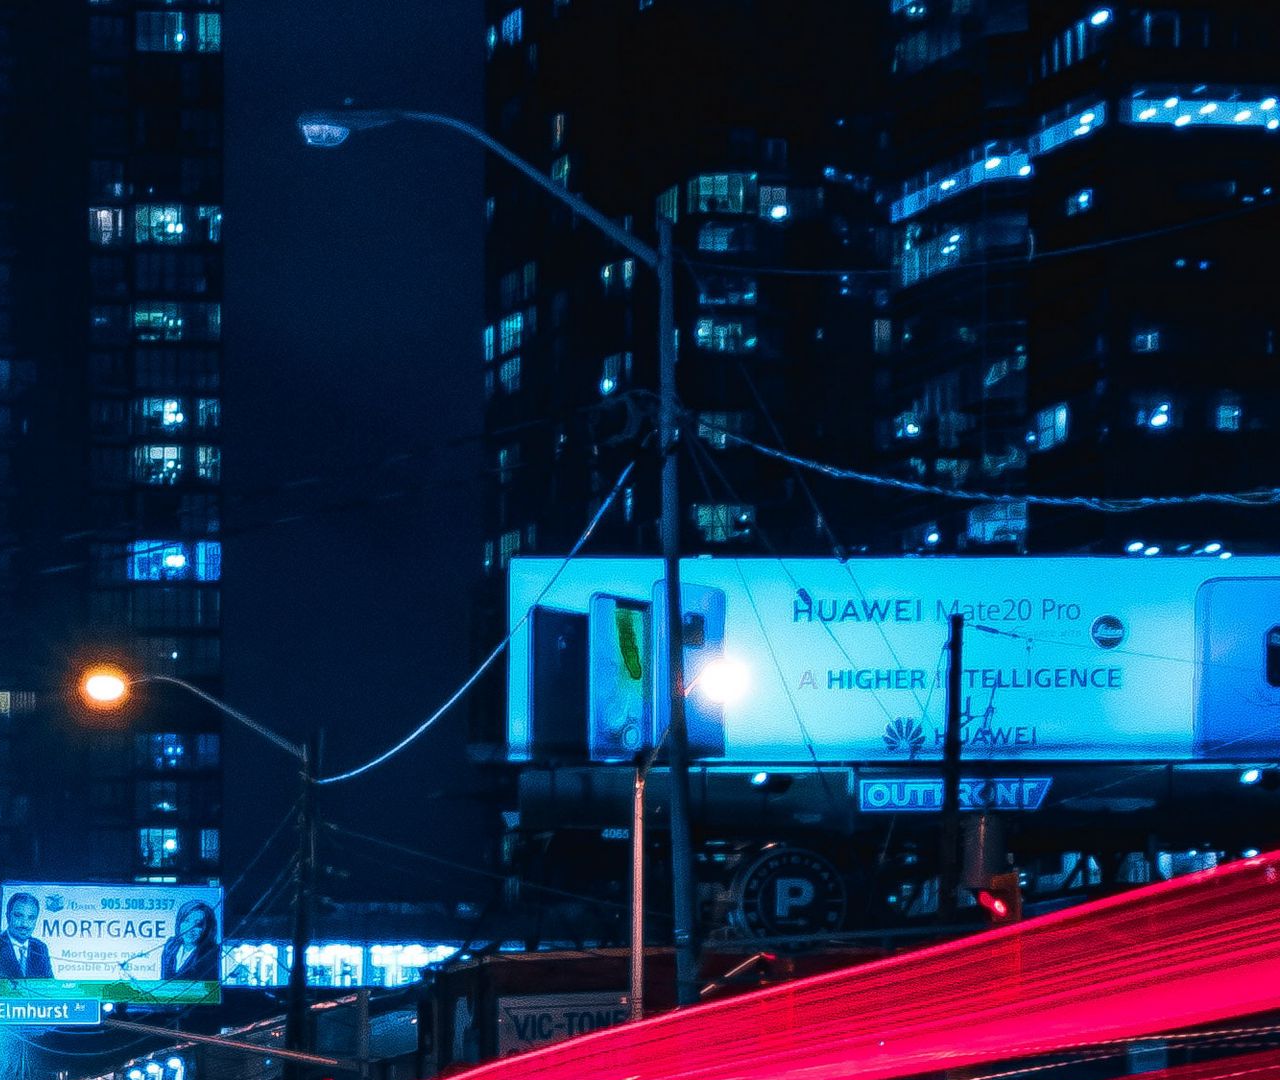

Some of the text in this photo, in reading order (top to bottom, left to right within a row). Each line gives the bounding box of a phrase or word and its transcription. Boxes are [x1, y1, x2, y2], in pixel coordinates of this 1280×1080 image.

[793, 598, 1082, 622] HUAWEI Mate20 Pro
[798, 669, 818, 690] A
[827, 669, 926, 690] HIGHER
[775, 877, 815, 918] P
[41, 919, 167, 938] MORTGAGE
[61, 949, 118, 961] Mortgages
[57, 962, 102, 973] possible
[104, 963, 116, 973] by
